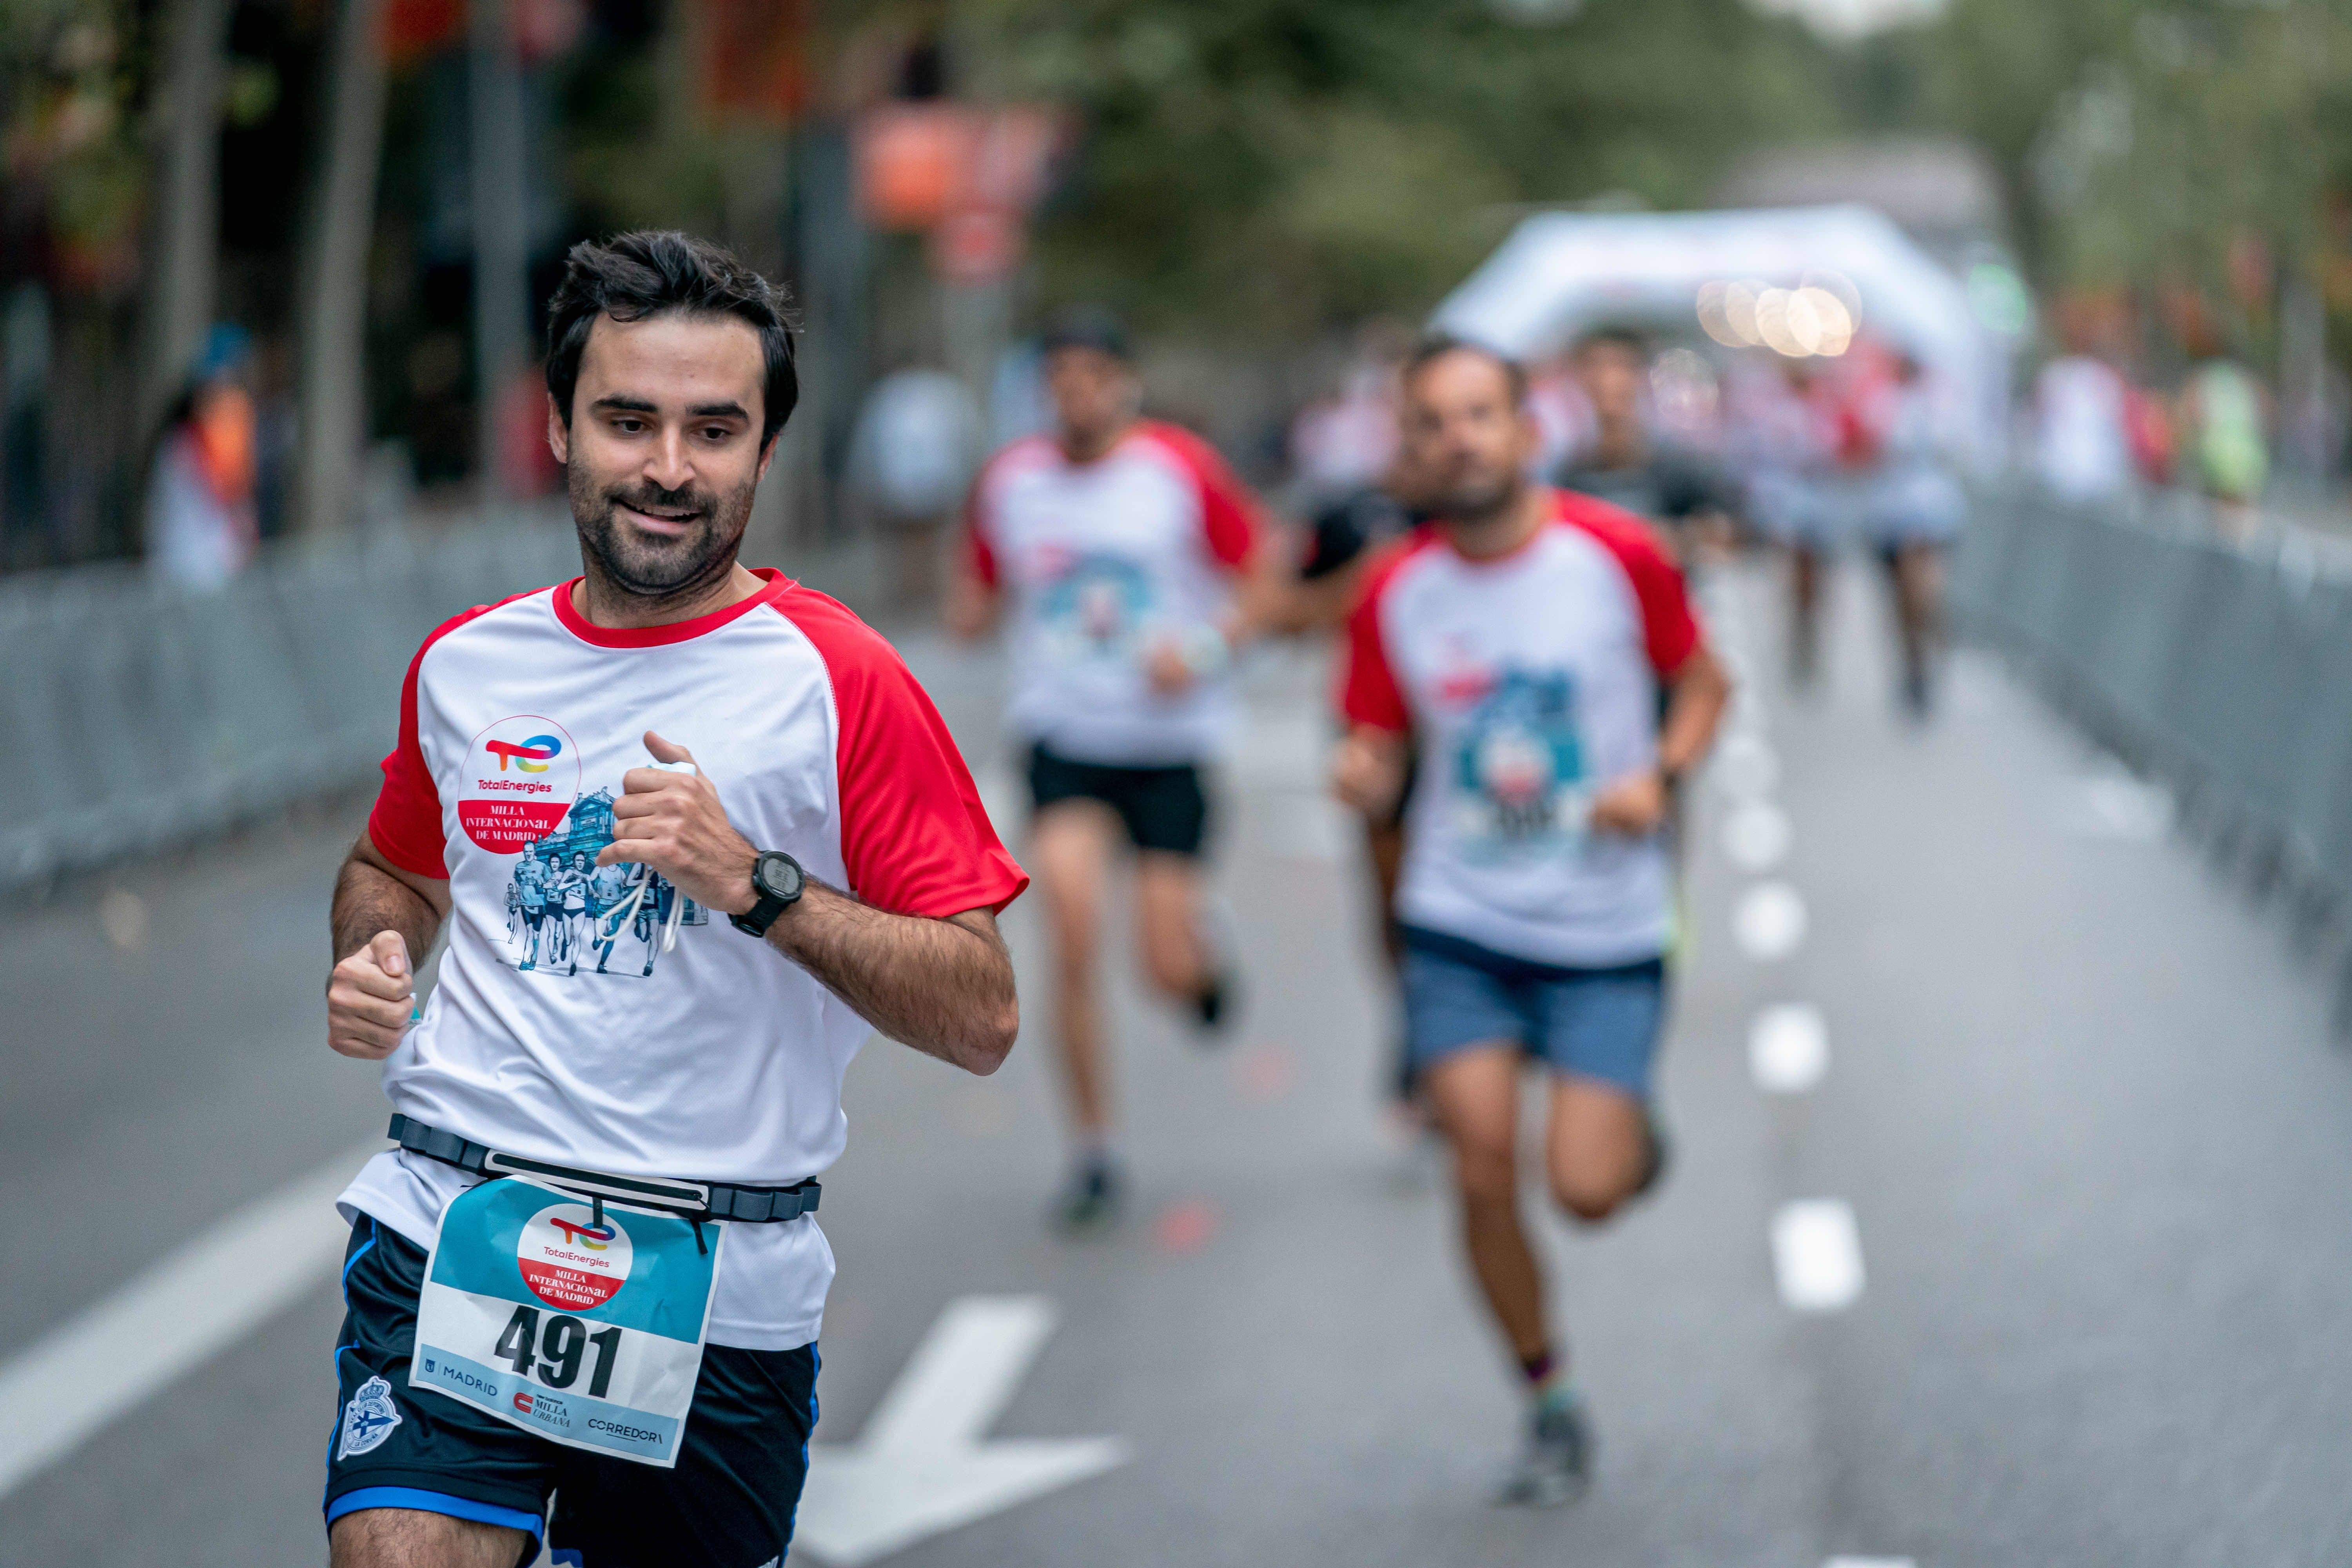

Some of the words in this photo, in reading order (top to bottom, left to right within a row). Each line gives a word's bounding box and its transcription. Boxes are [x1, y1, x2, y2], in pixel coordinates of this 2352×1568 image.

[478, 780, 552, 794] TotalEnergies
[490, 805, 524, 815] MILLA
[476, 830, 490, 839] DE
[492, 830, 536, 841] MADRID
[544, 1247, 610, 1267] TotalEnergies
[555, 1270, 586, 1283] MILLA
[539, 1286, 553, 1296] DE
[555, 1290, 594, 1305] MADRID
[494, 1305, 622, 1399] 491
[443, 1366, 497, 1396] MADRID
[535, 1399, 567, 1417] MILLA
[533, 1409, 570, 1427] URBANA
